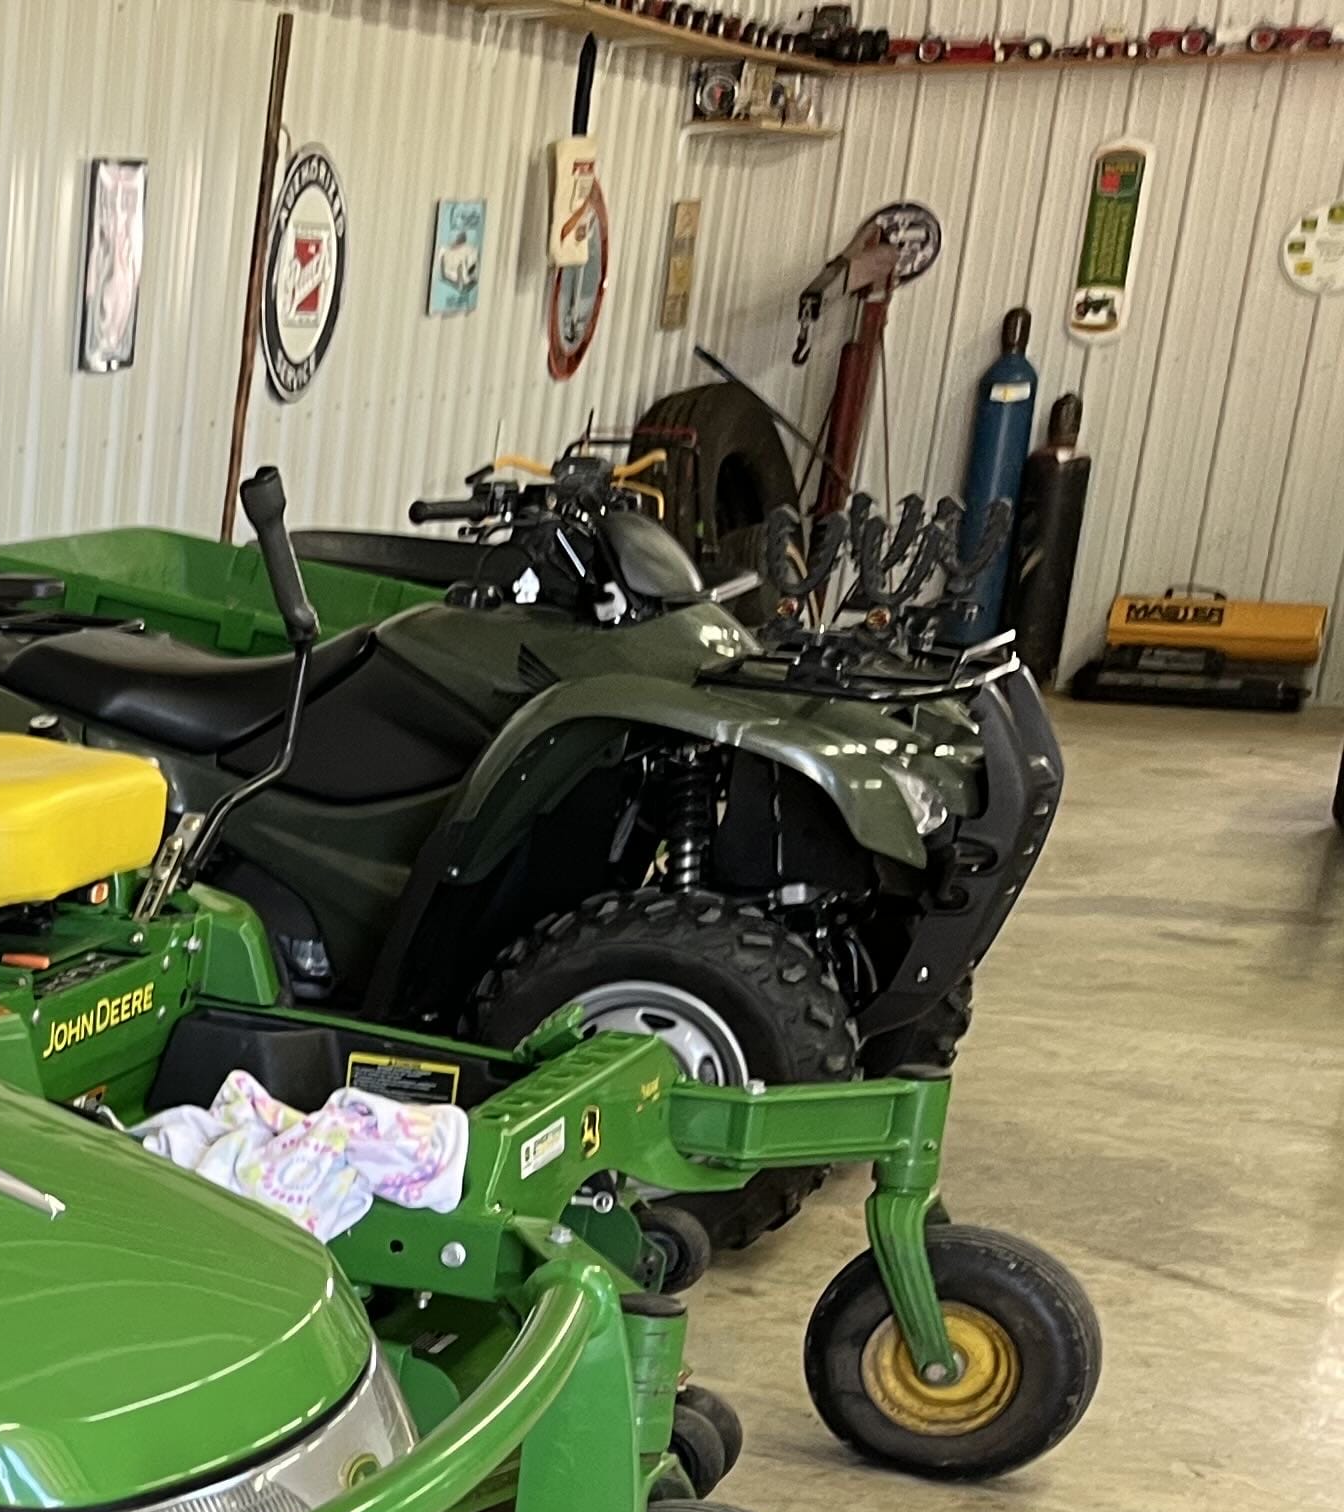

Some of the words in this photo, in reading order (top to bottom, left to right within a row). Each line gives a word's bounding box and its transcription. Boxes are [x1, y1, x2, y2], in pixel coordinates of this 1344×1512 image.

[1125, 604, 1225, 627] MASTER
[43, 1010, 95, 1059] JOHN
[95, 982, 156, 1034] DEERE
